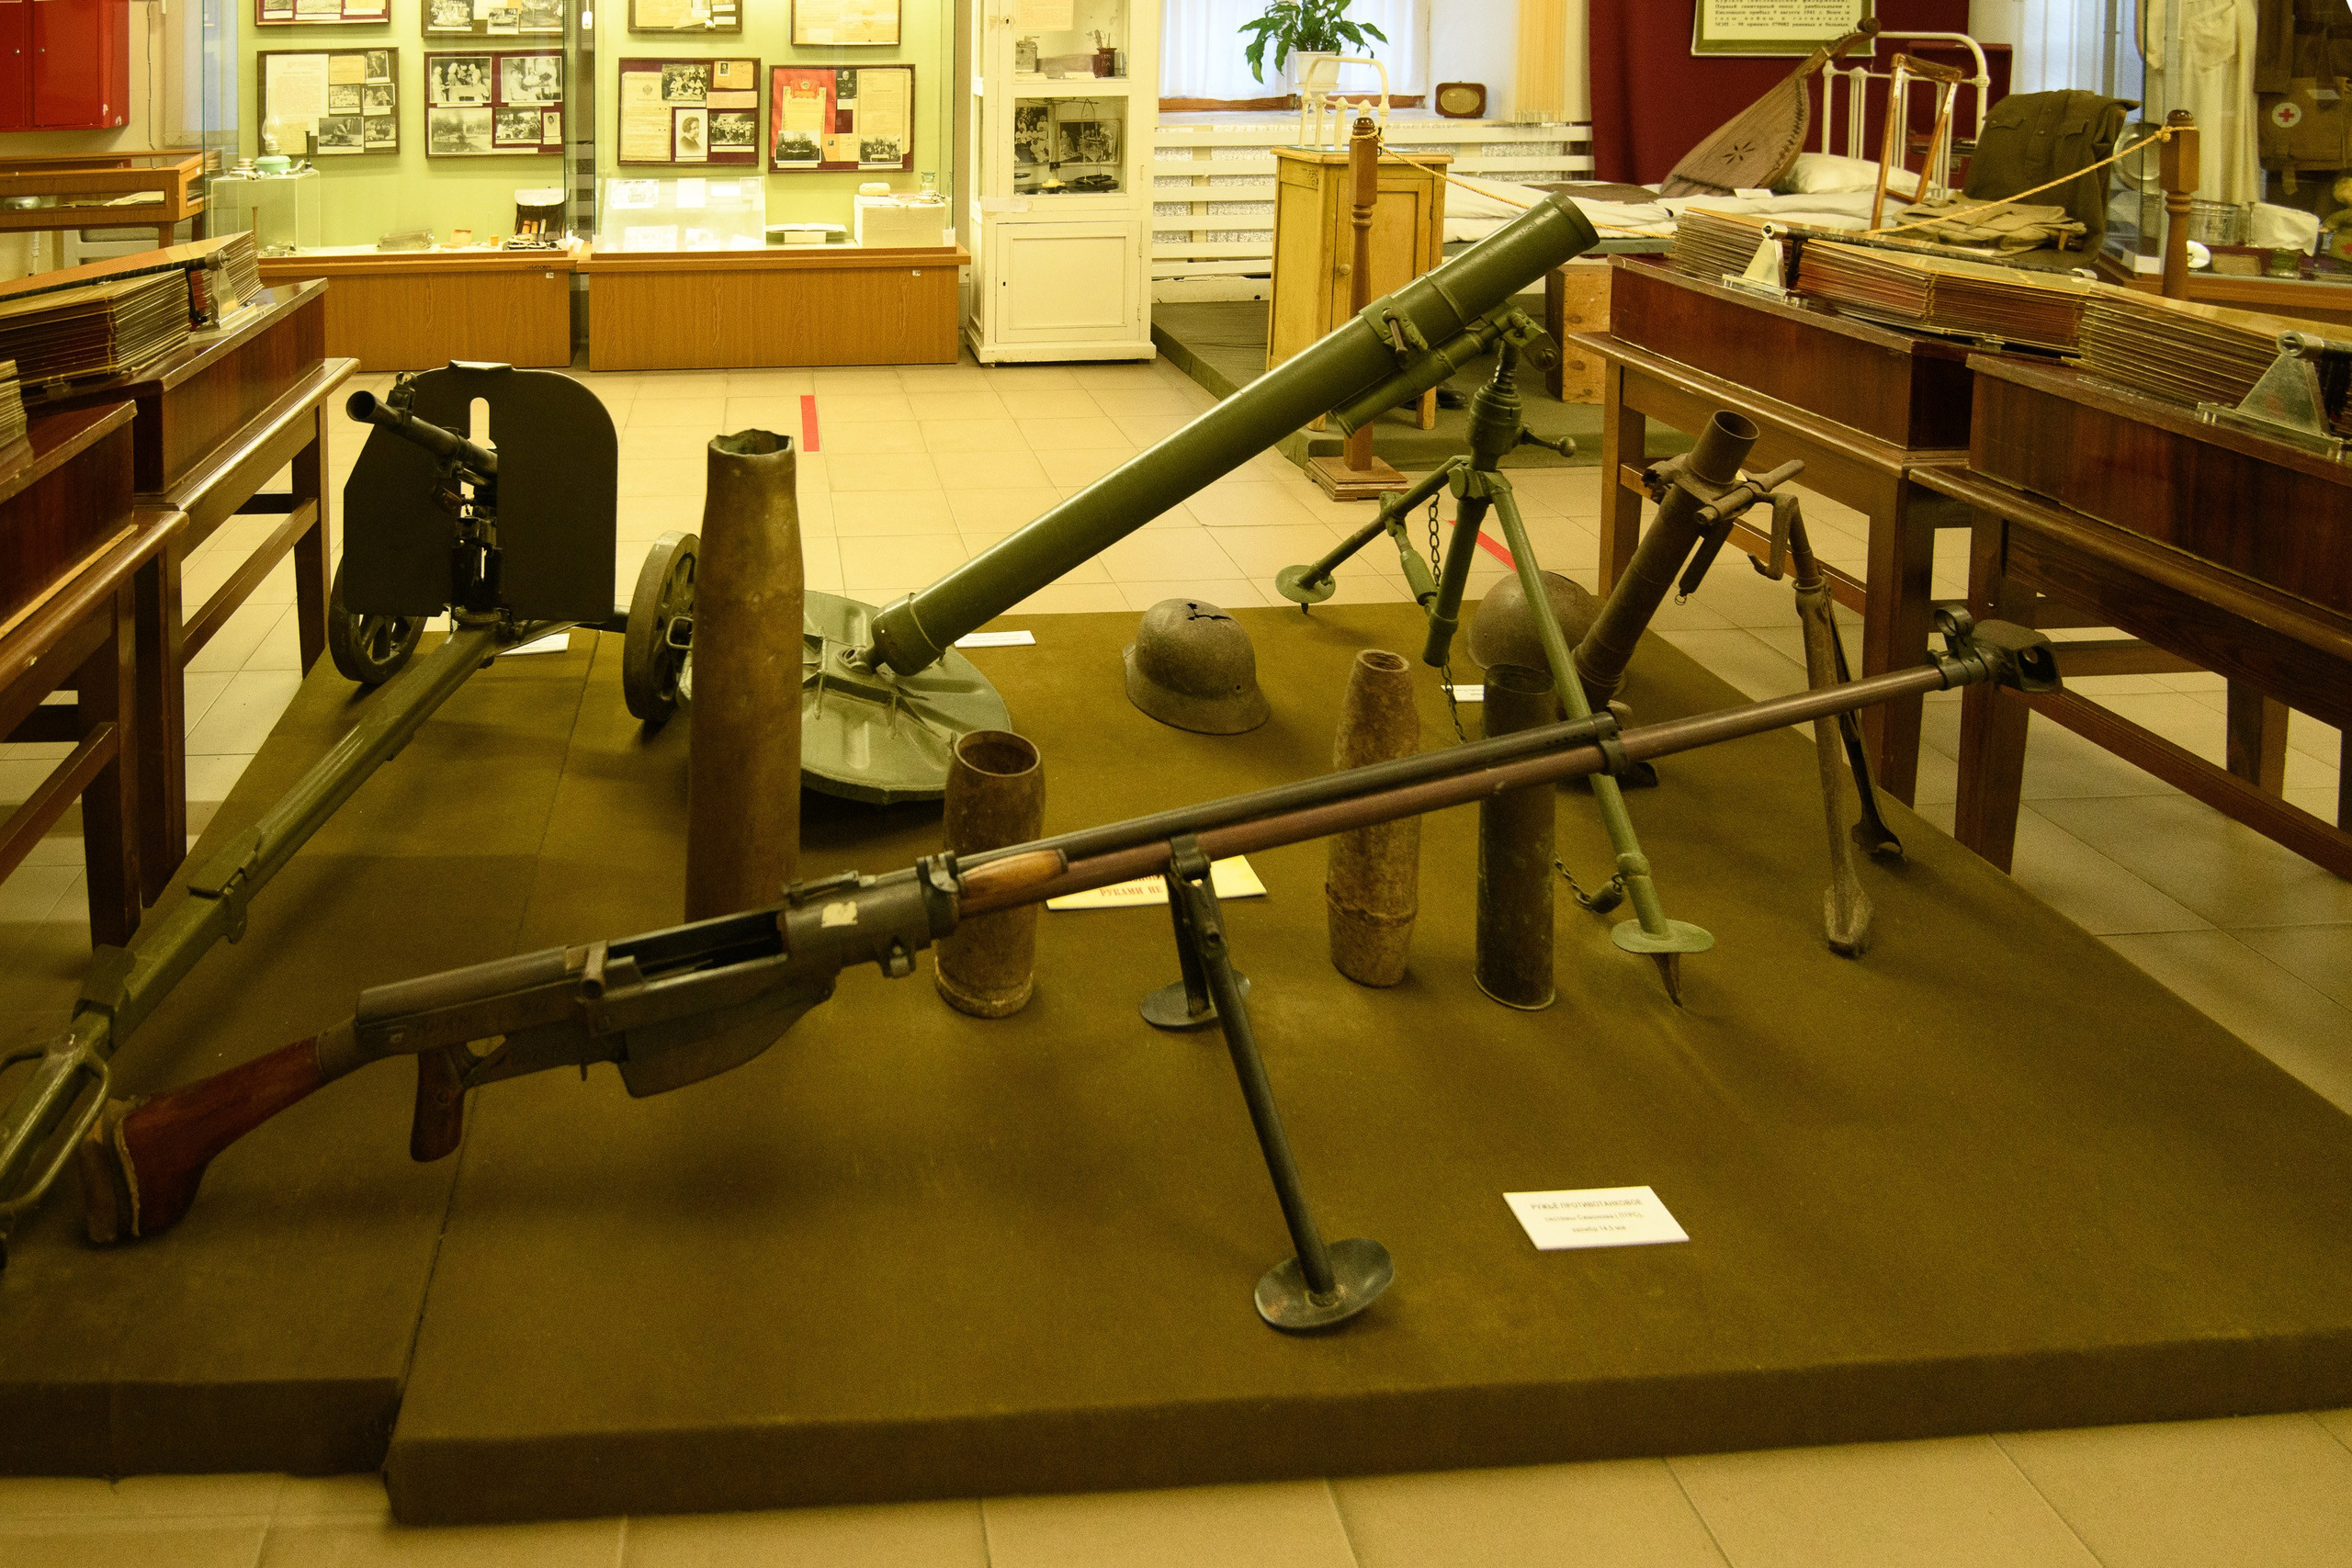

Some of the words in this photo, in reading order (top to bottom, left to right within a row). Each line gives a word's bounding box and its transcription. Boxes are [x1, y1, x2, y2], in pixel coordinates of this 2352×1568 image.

[1099, 887, 1144, 897] РУКАМИ
[1148, 886, 1163, 894] НЕ
[1560, 1198, 1643, 1209] ПРОТИВОТАНКОВОЕ
[1577, 1213, 1614, 1222] Симонова
